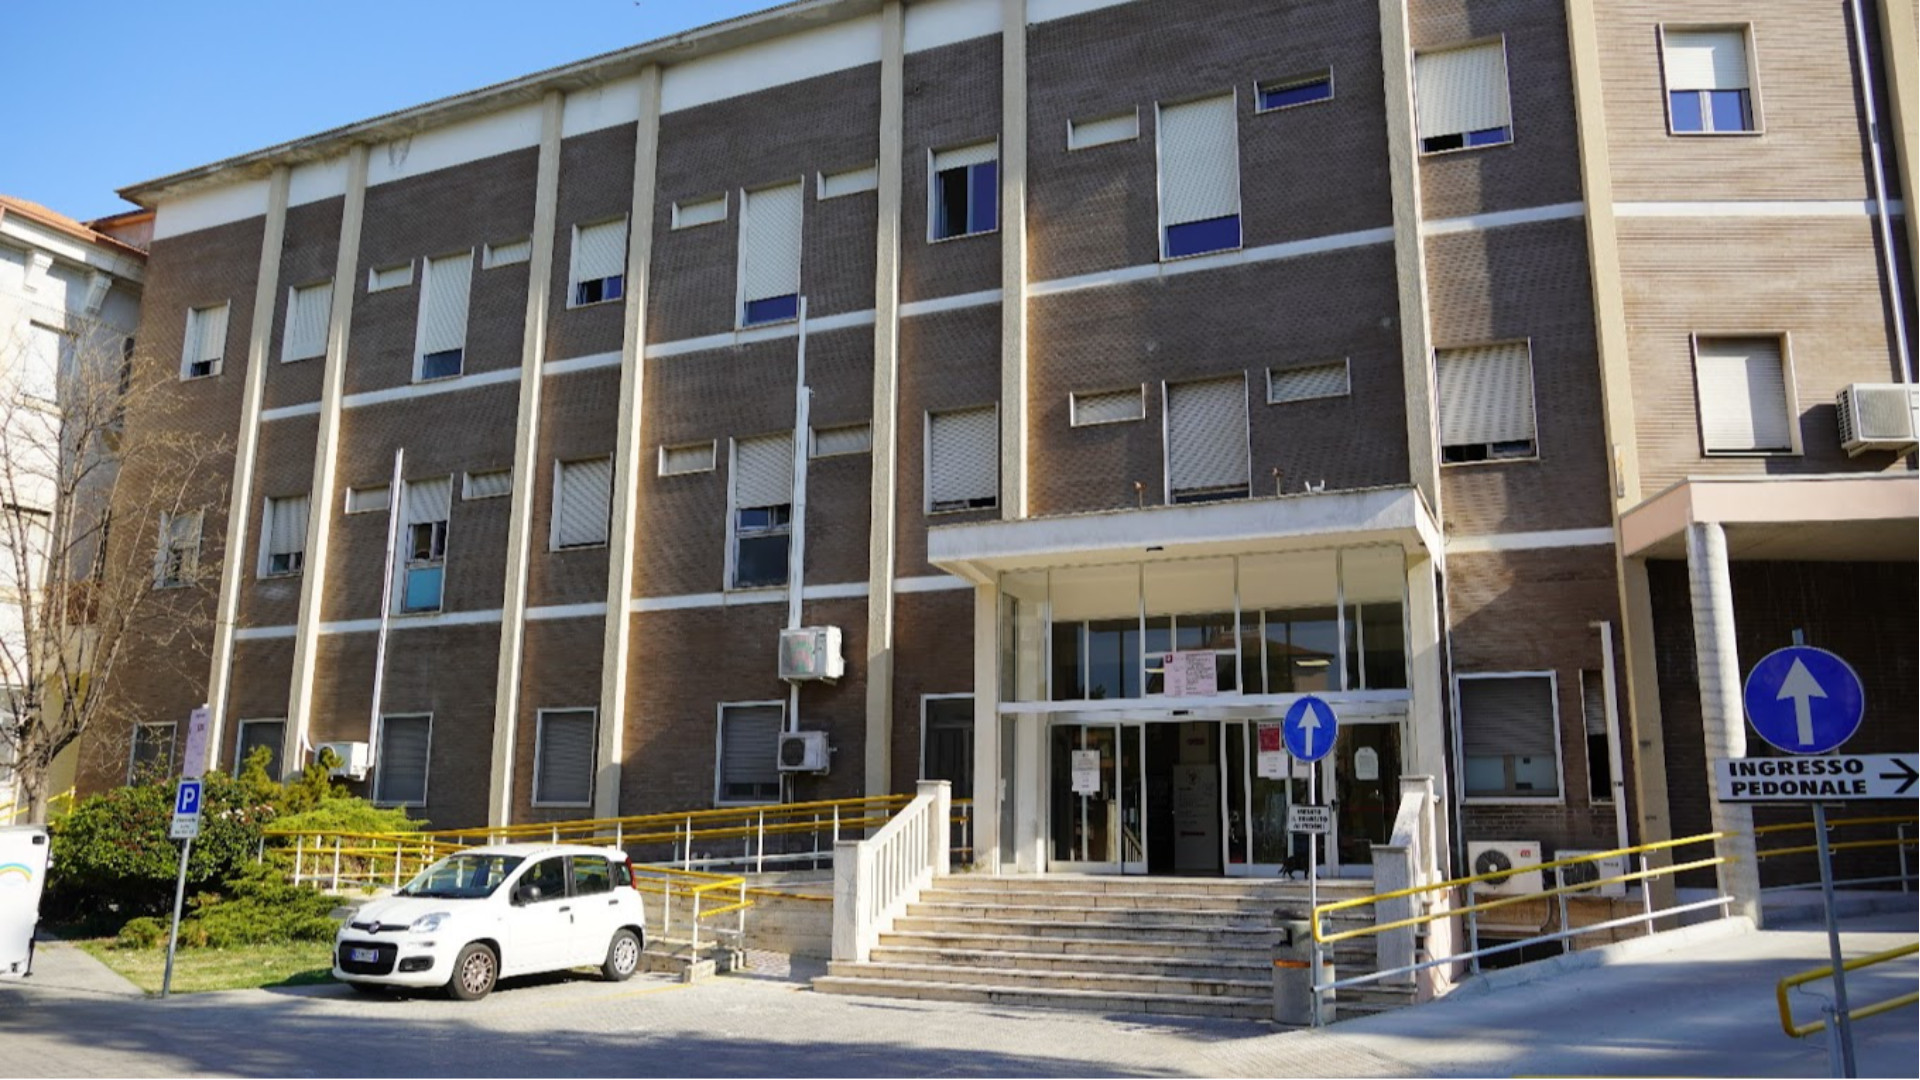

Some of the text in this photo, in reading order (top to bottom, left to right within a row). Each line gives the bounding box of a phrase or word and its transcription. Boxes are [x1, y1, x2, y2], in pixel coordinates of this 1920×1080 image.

[1729, 759, 1864, 777] INGRESSO
[1731, 780, 1867, 796] PEDONALE
[182, 787, 196, 811] P
